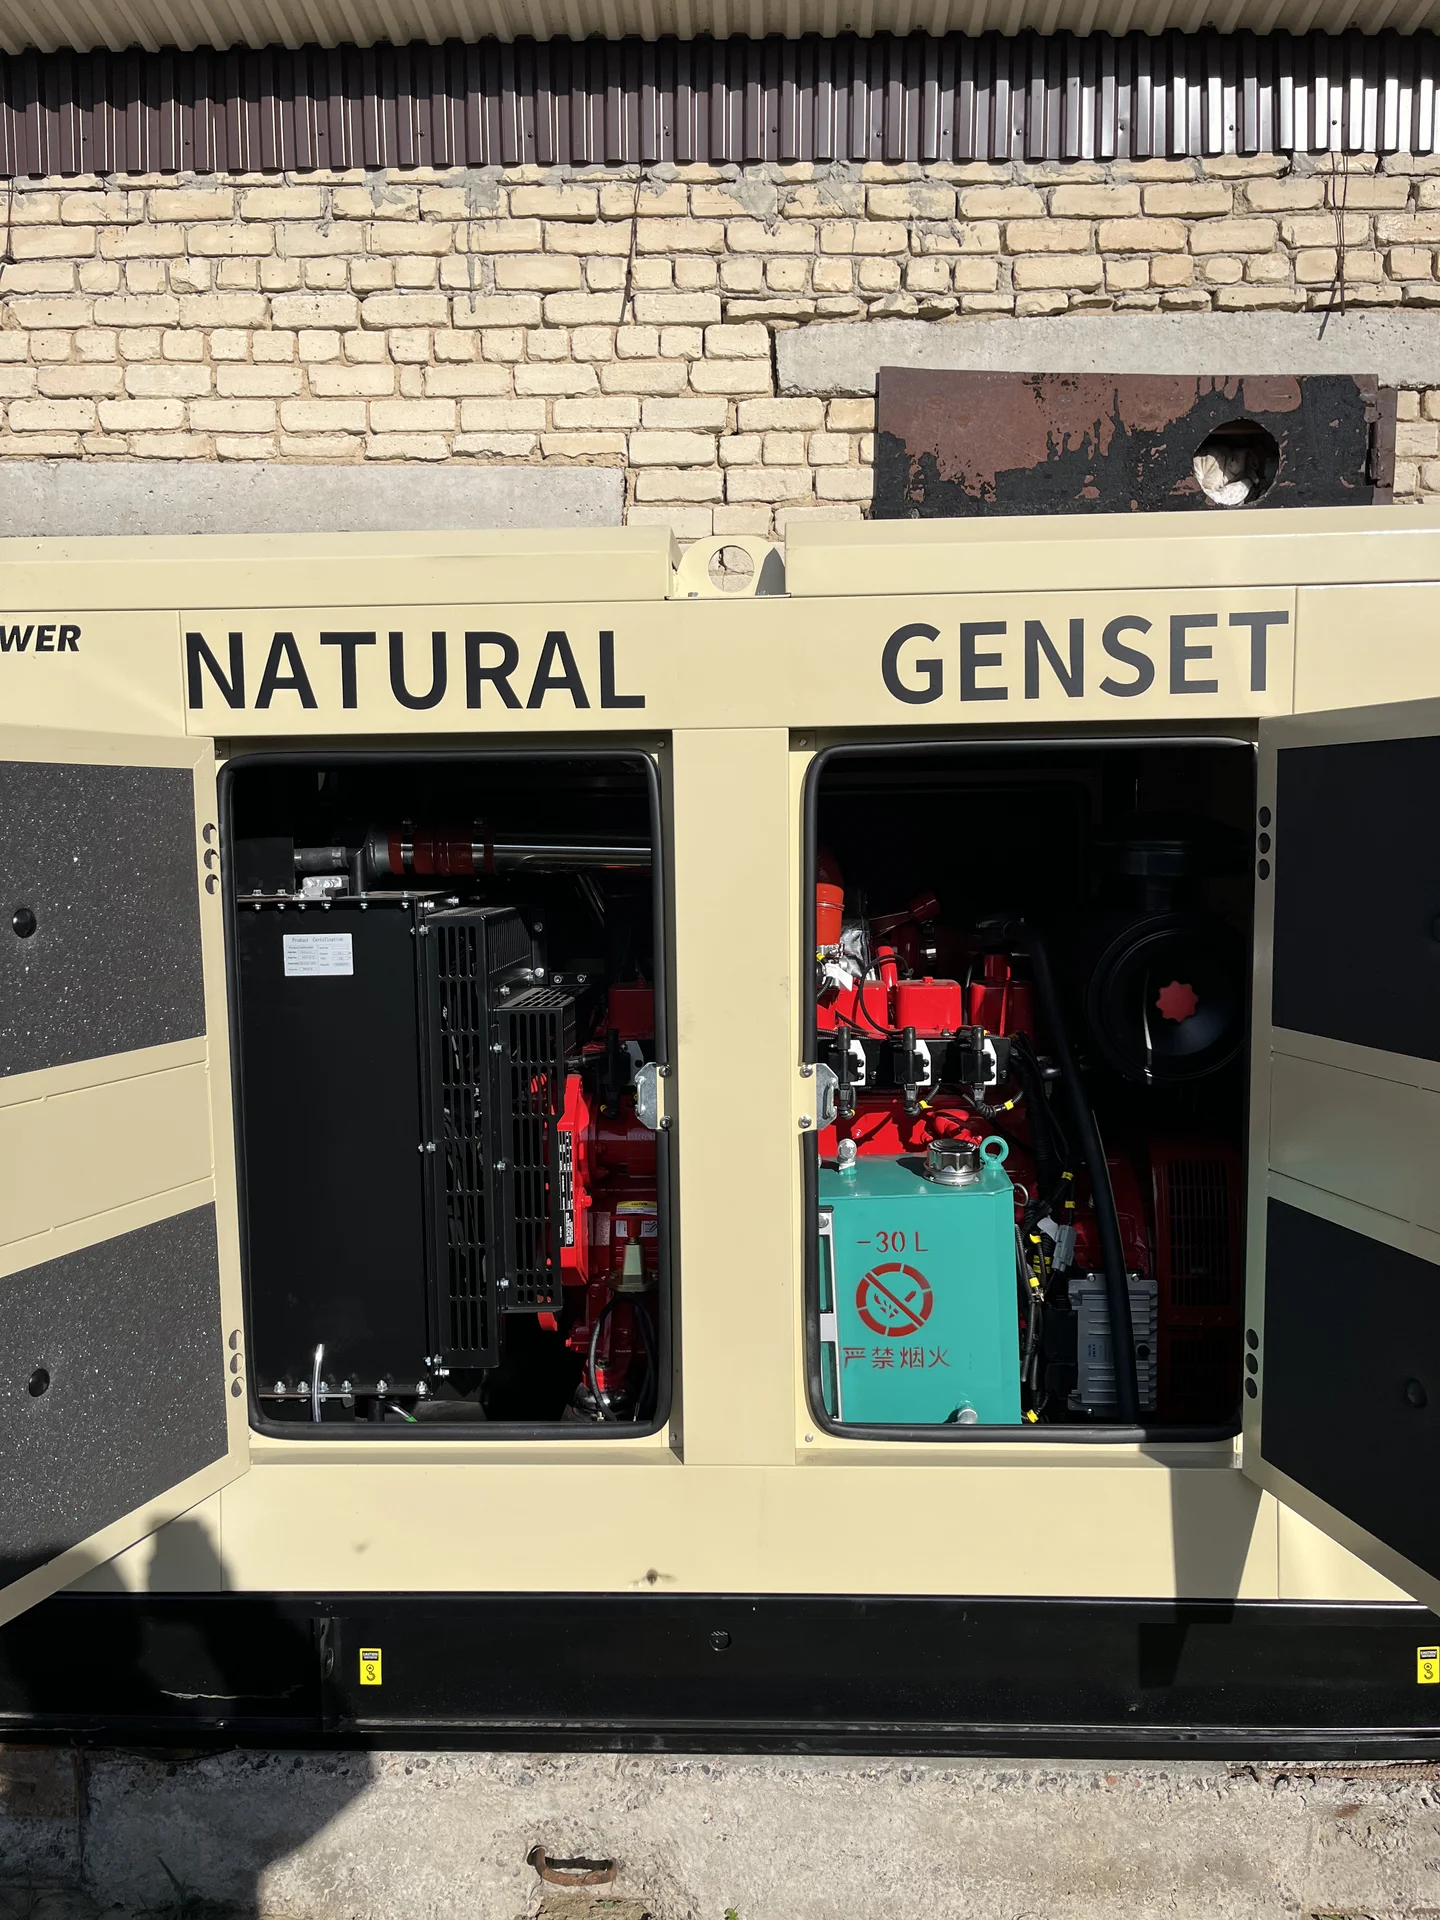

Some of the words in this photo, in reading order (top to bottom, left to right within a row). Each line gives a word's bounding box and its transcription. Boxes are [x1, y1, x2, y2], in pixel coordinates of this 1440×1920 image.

[186, 630, 645, 710] NATURAL
[881, 610, 1289, 705] GENSET
[842, 1345, 951, 1370] 严禁烟火
